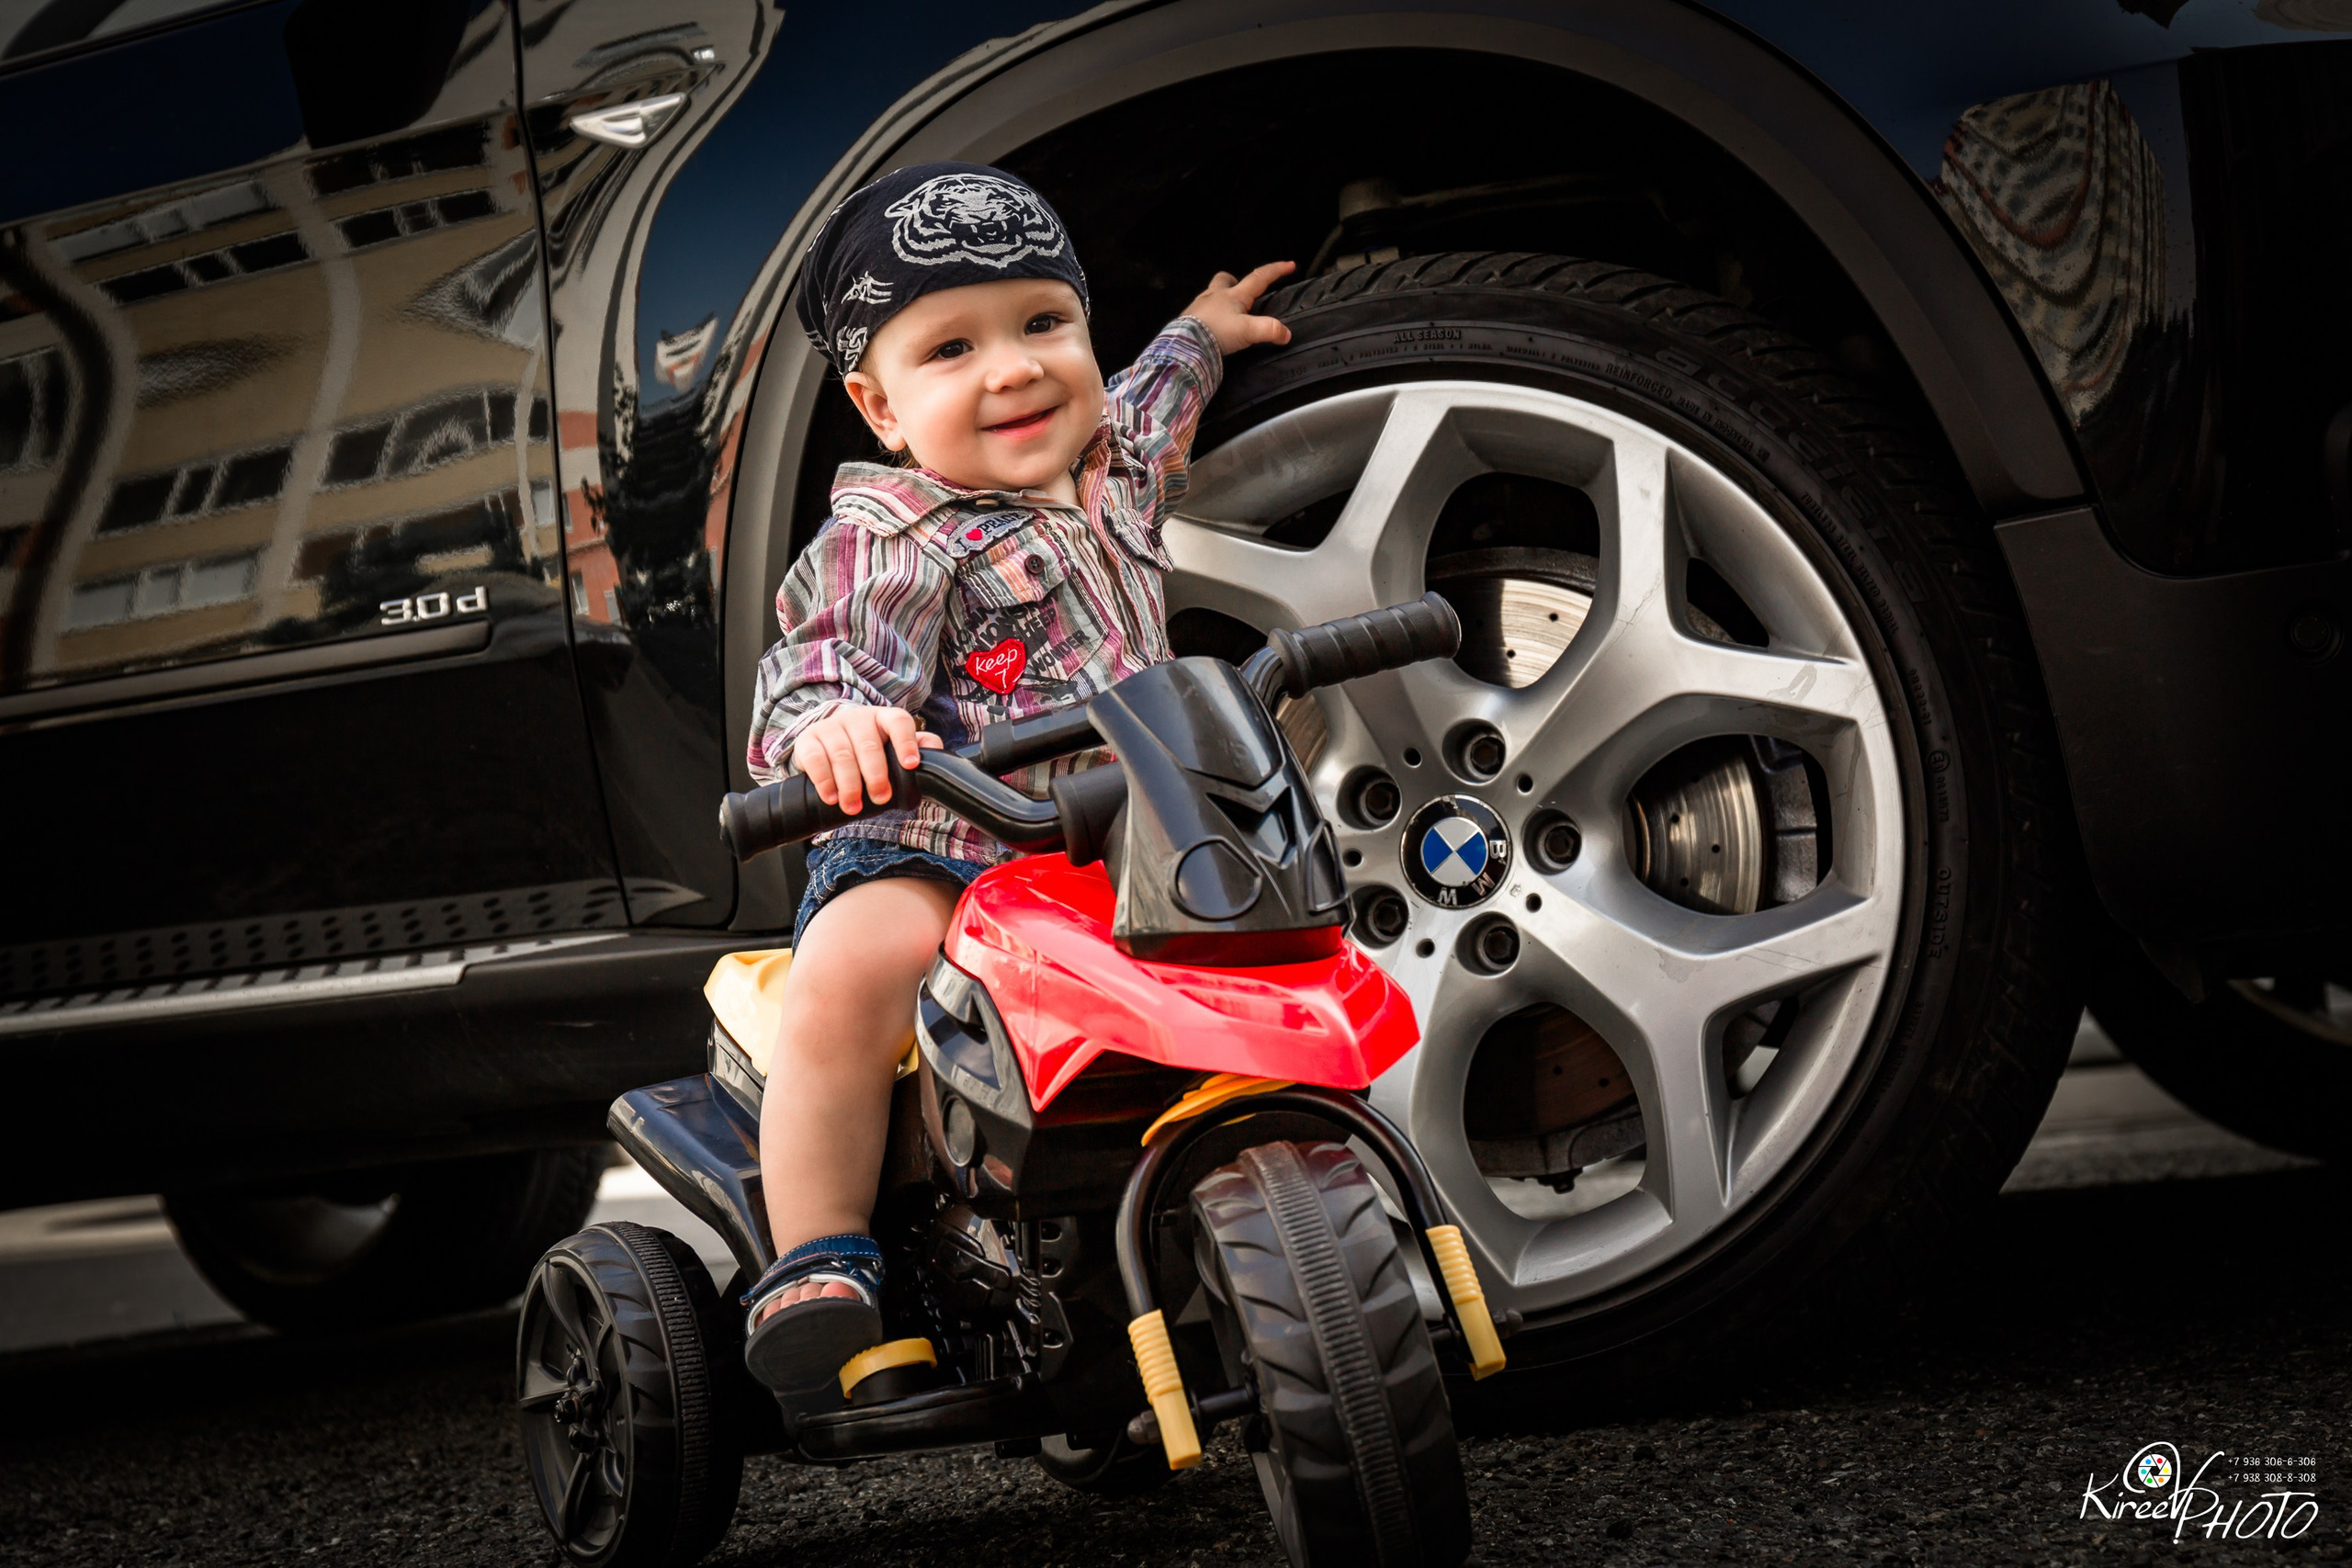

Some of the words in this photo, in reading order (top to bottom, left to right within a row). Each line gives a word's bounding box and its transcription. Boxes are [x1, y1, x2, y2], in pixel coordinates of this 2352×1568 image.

[1392, 331, 1414, 344] ALL
[1417, 328, 1461, 341] SEASON
[1604, 362, 1674, 399] REINFORCED
[1675, 395, 1701, 415] MADE
[1701, 410, 1713, 423] IN
[1713, 417, 1755, 451] INDONESIA
[1834, 532, 1860, 563] STEEL
[1026, 629, 1091, 676] WONDER
[1926, 866, 1951, 960] OUTSIDE
